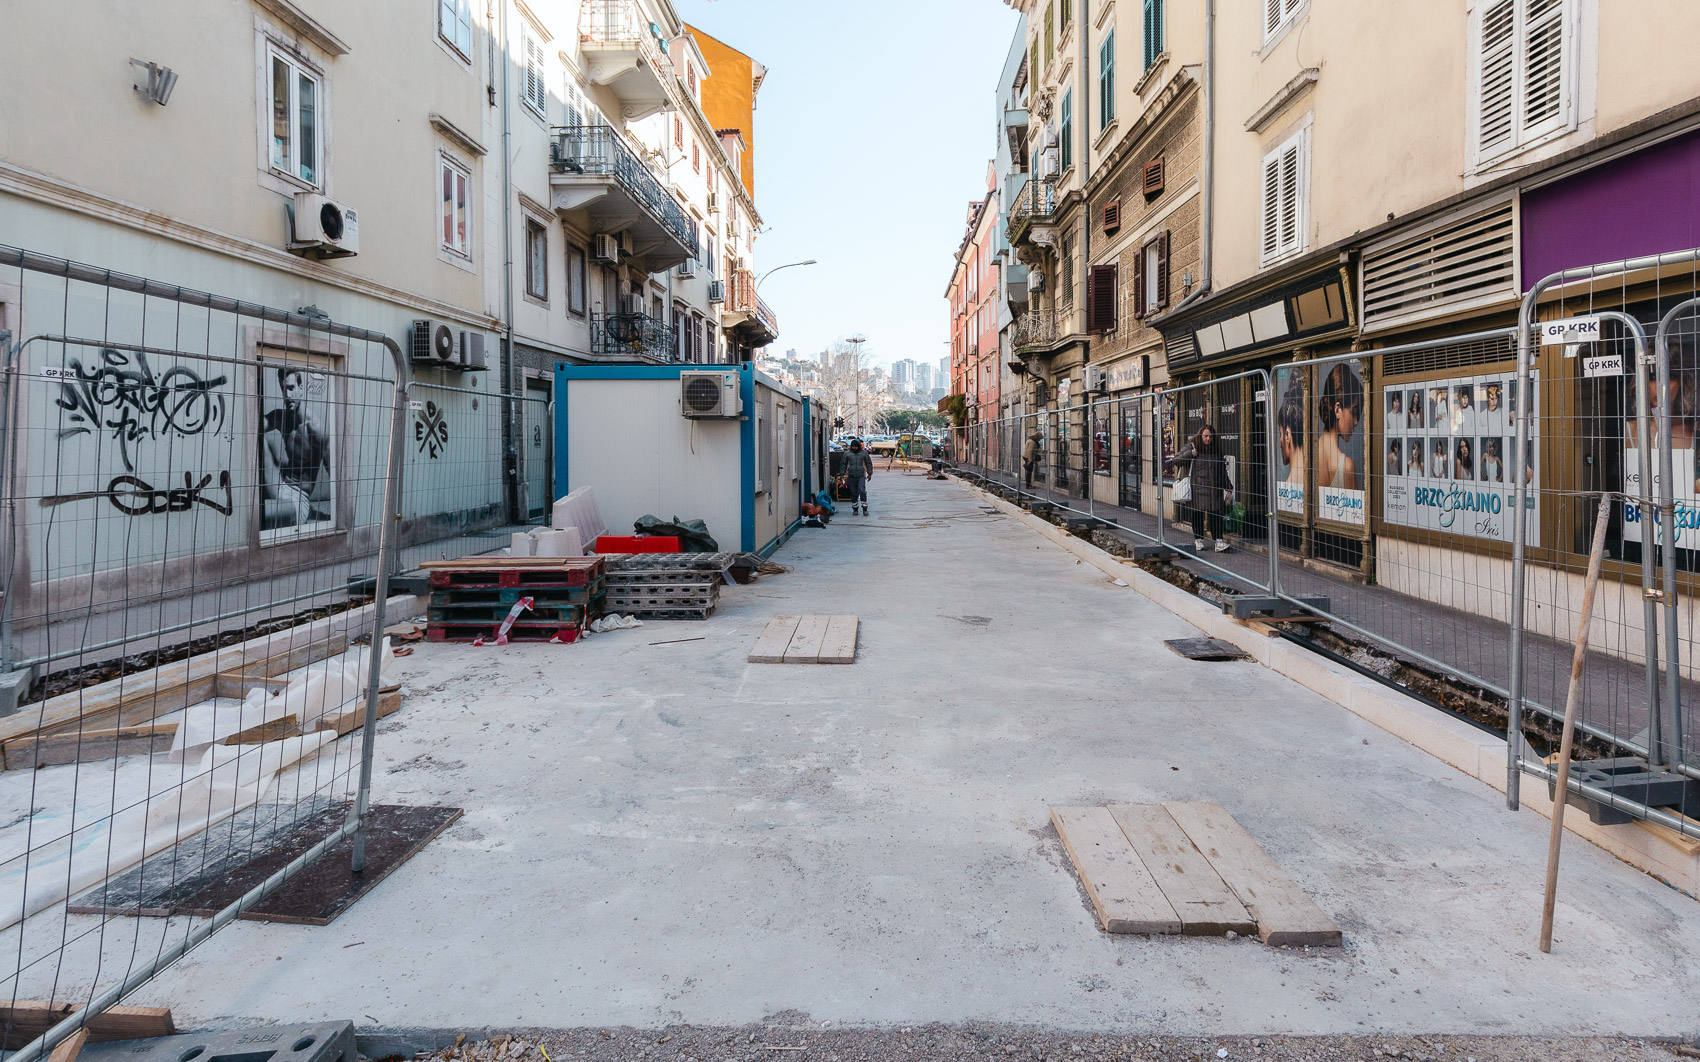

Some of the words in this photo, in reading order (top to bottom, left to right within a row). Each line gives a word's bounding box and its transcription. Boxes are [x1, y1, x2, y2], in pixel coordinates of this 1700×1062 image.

[1548, 325, 1565, 336] GP
[1568, 321, 1598, 333] KRK
[1588, 361, 1600, 370] GP
[1601, 359, 1621, 369] KRK
[45, 369, 58, 377] GP
[59, 370, 75, 378] KRK
[1414, 486, 1445, 508] BRZO
